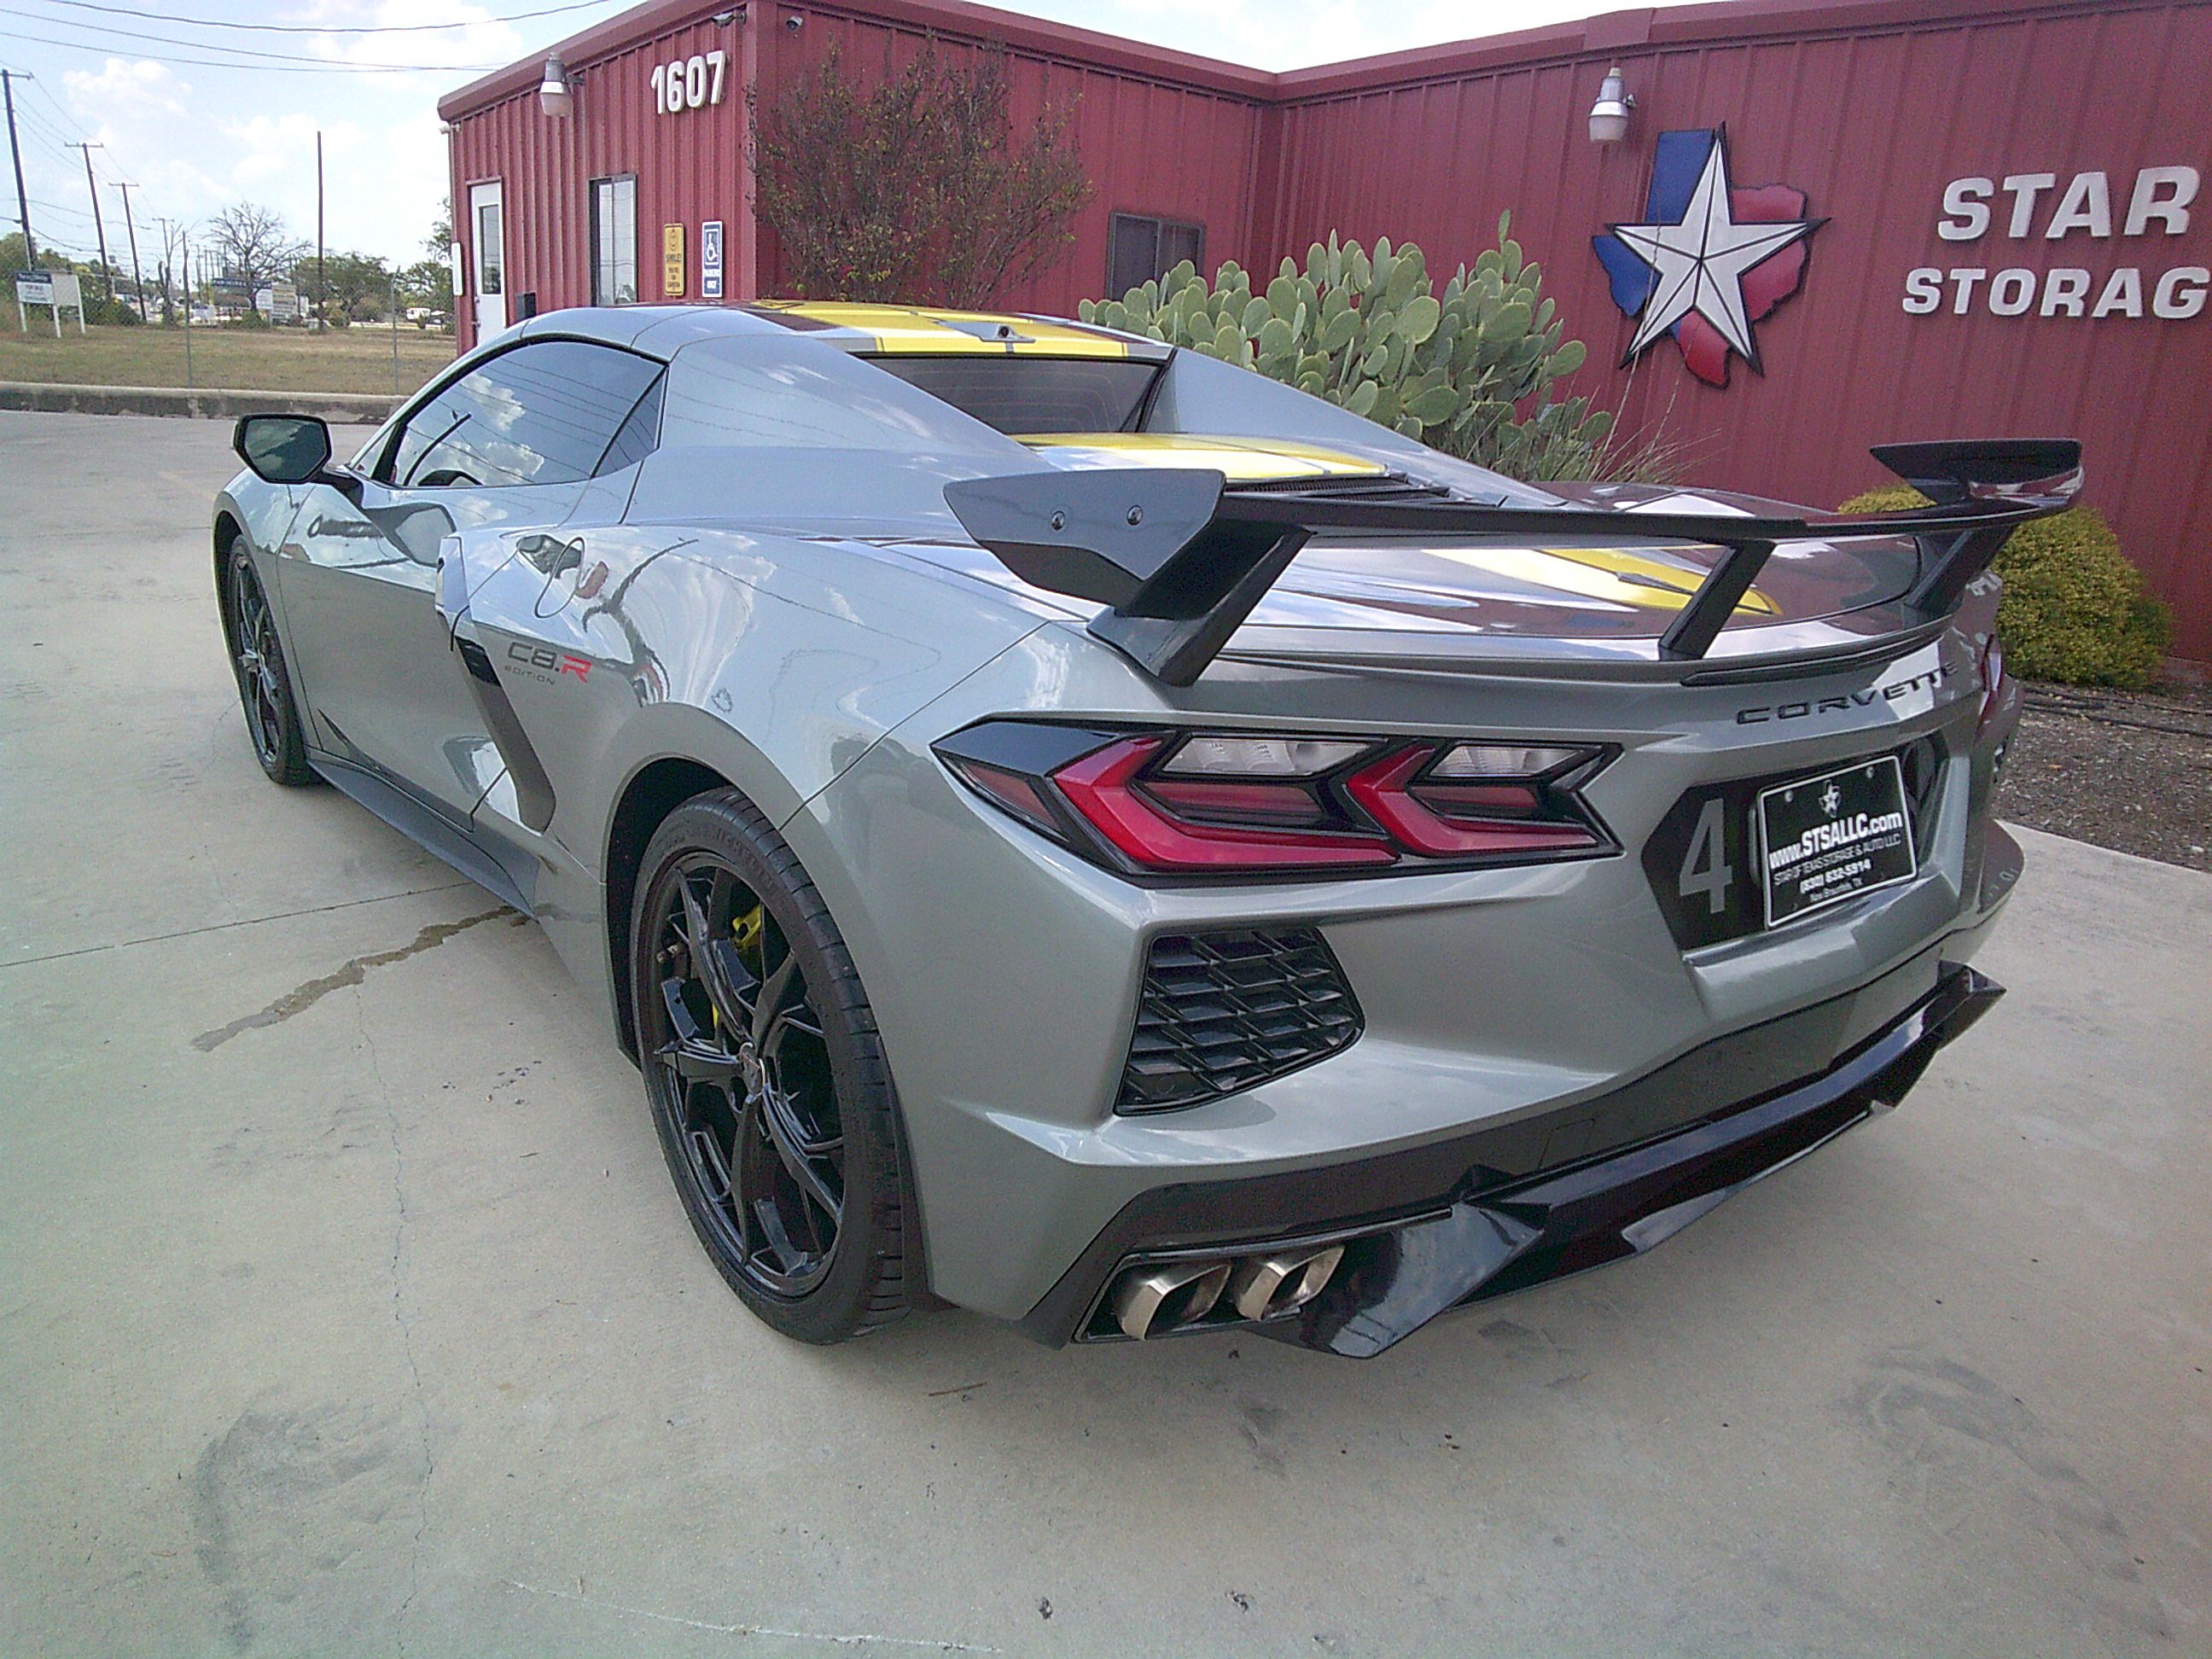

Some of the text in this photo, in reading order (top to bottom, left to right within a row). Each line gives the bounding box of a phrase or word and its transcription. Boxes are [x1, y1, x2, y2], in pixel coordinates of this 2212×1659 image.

[650, 50, 725, 114] 1607
[1937, 166, 2201, 241] STAR
[1902, 266, 2211, 319] STORAG
[504, 665, 555, 685] EDITION
[1736, 662, 1959, 725] CORVETTE
[1679, 798, 1732, 914] 4
[1768, 812, 1903, 870] www.STSALLC.com
[1883, 831, 1902, 847] LLC
